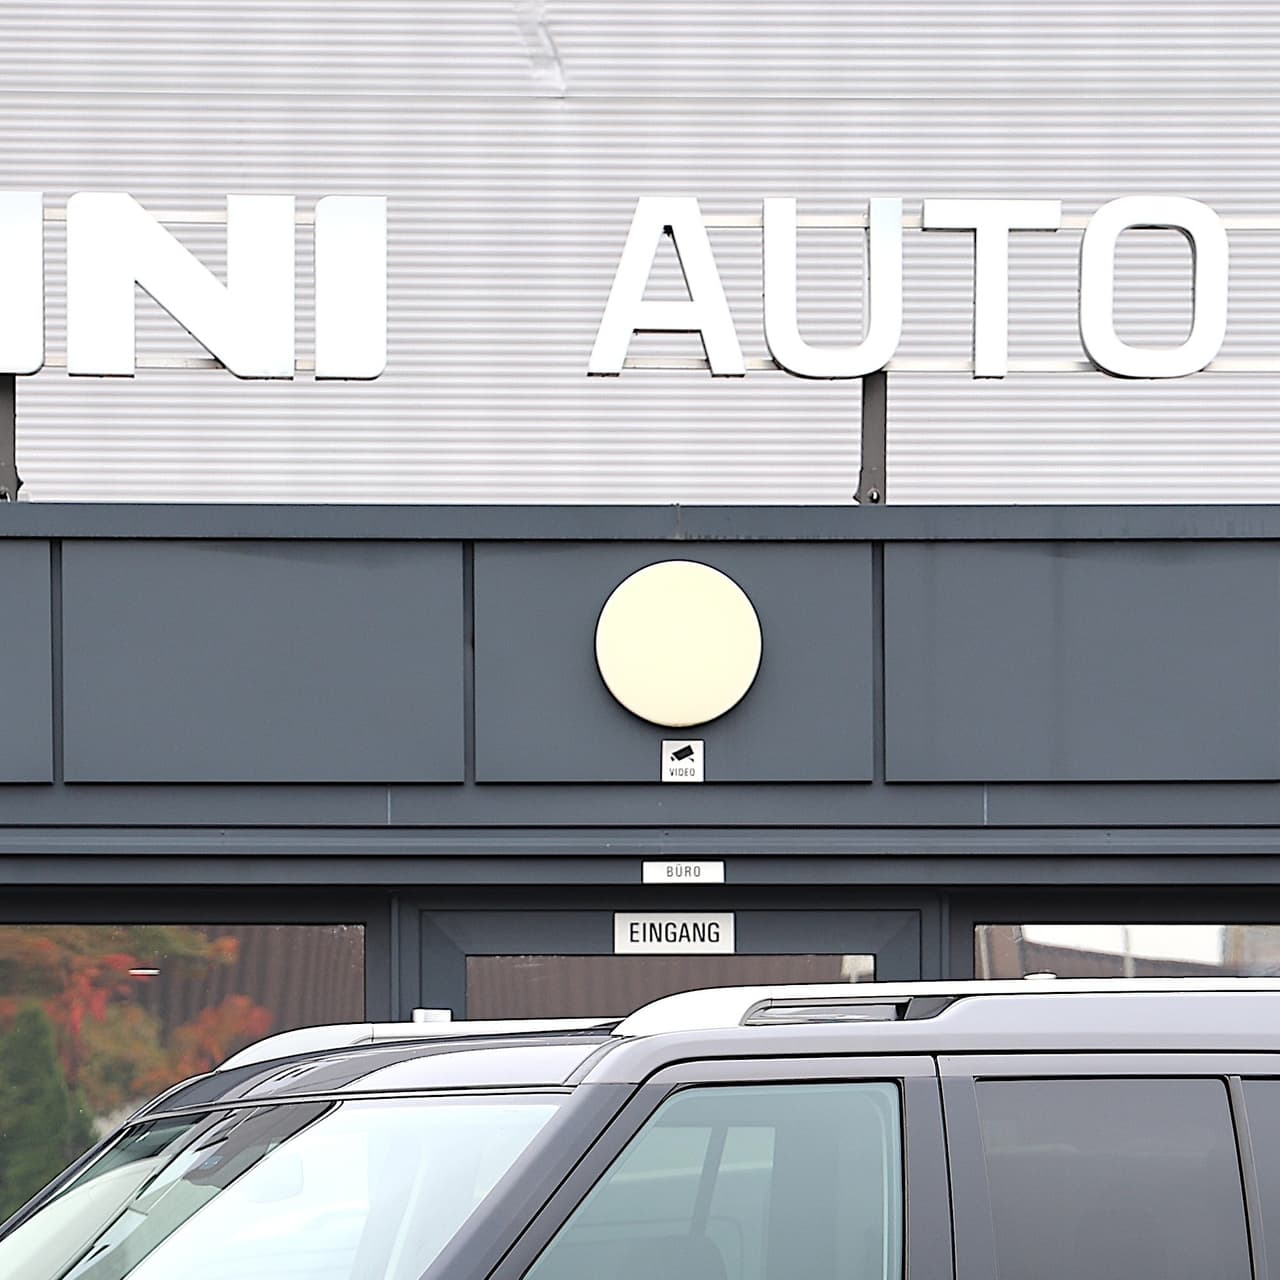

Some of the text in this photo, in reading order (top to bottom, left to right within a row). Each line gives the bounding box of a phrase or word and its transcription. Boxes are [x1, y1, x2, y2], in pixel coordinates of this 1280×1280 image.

[586, 194, 1229, 381] AUTO
[669, 767, 696, 777] VIDEO
[666, 863, 702, 878] BÜRO
[629, 921, 721, 944] EINGANG
